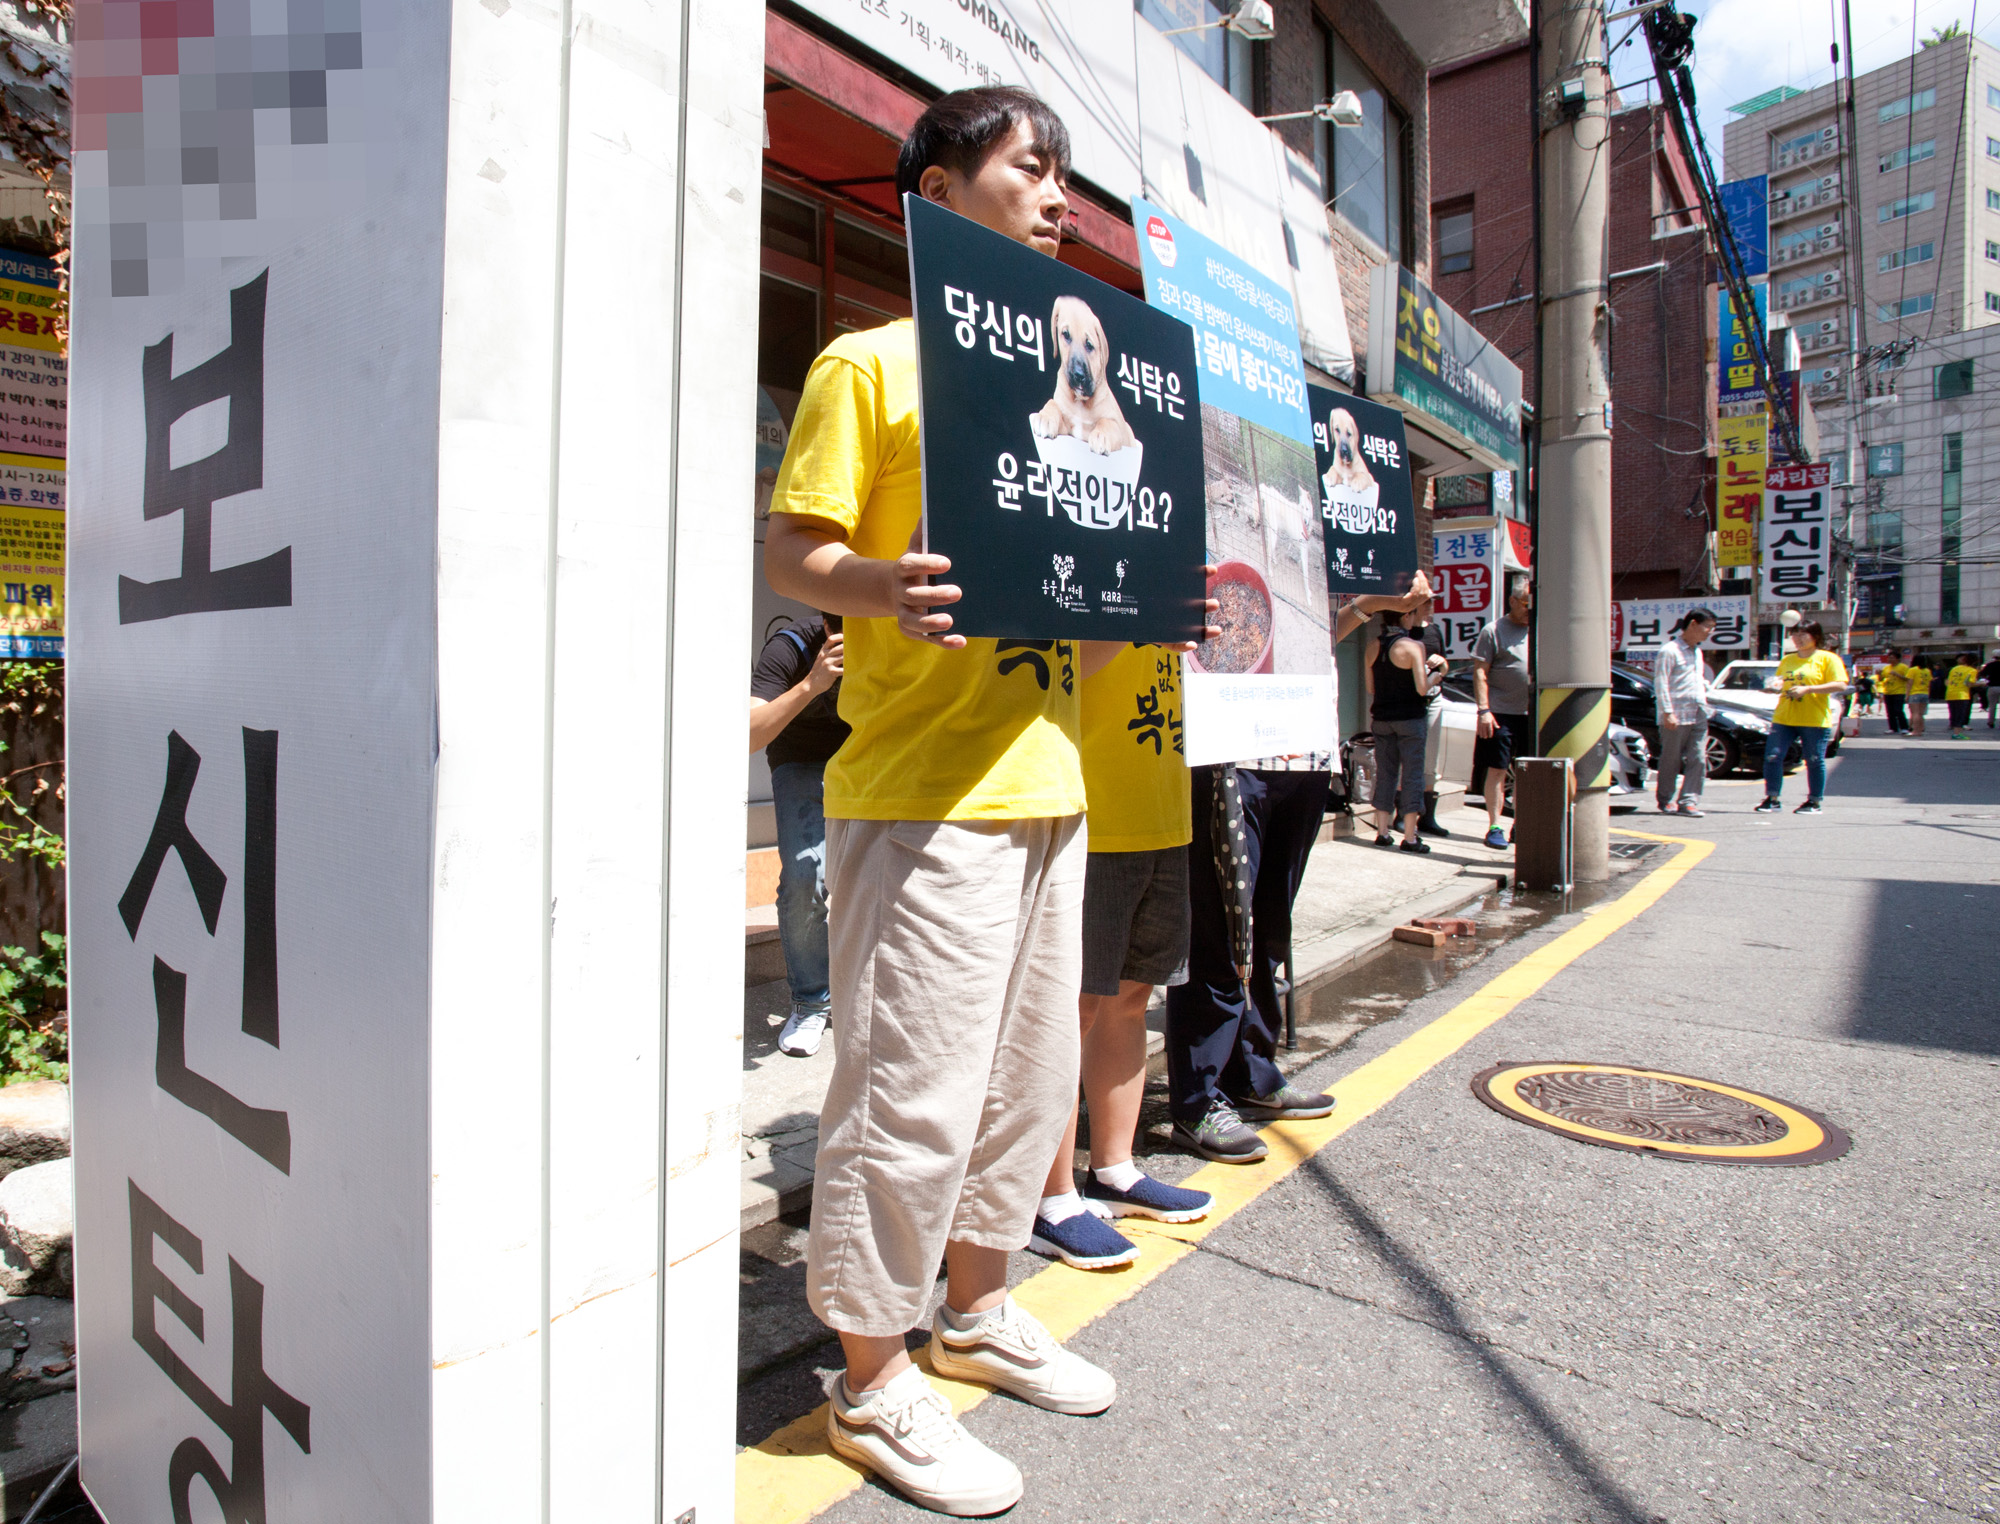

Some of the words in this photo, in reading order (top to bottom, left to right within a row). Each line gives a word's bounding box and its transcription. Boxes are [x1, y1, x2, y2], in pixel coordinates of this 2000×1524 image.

[1150, 223, 1167, 237] STOP
[1205, 257, 1294, 331] #반려동물식용금지
[1157, 277, 1182, 310] 침과
[1182, 290, 1204, 322] 오물
[1204, 300, 1234, 336] 범벅인
[1233, 316, 1275, 358] 음식쓰레기
[1396, 285, 1442, 376] 조은
[9, 351, 36, 366] 강의
[943, 284, 1045, 372] 당신의
[1117, 353, 1186, 421] 식탁은
[1204, 331, 1241, 384] 몸에
[1241, 348, 1304, 414] 좋다구요?
[1362, 434, 1401, 469] 식탁은
[992, 452, 1173, 533] 윤리적인가요?
[1724, 460, 1762, 524] 노래
[1767, 465, 1830, 489] 싸리골
[1446, 533, 1491, 559] 전통
[1720, 528, 1753, 547] 연습
[1769, 491, 1825, 598] 보신탕
[0, 563, 32, 574] 비지원
[4, 583, 53, 607] 파워
[1628, 603, 1661, 614] 농장을
